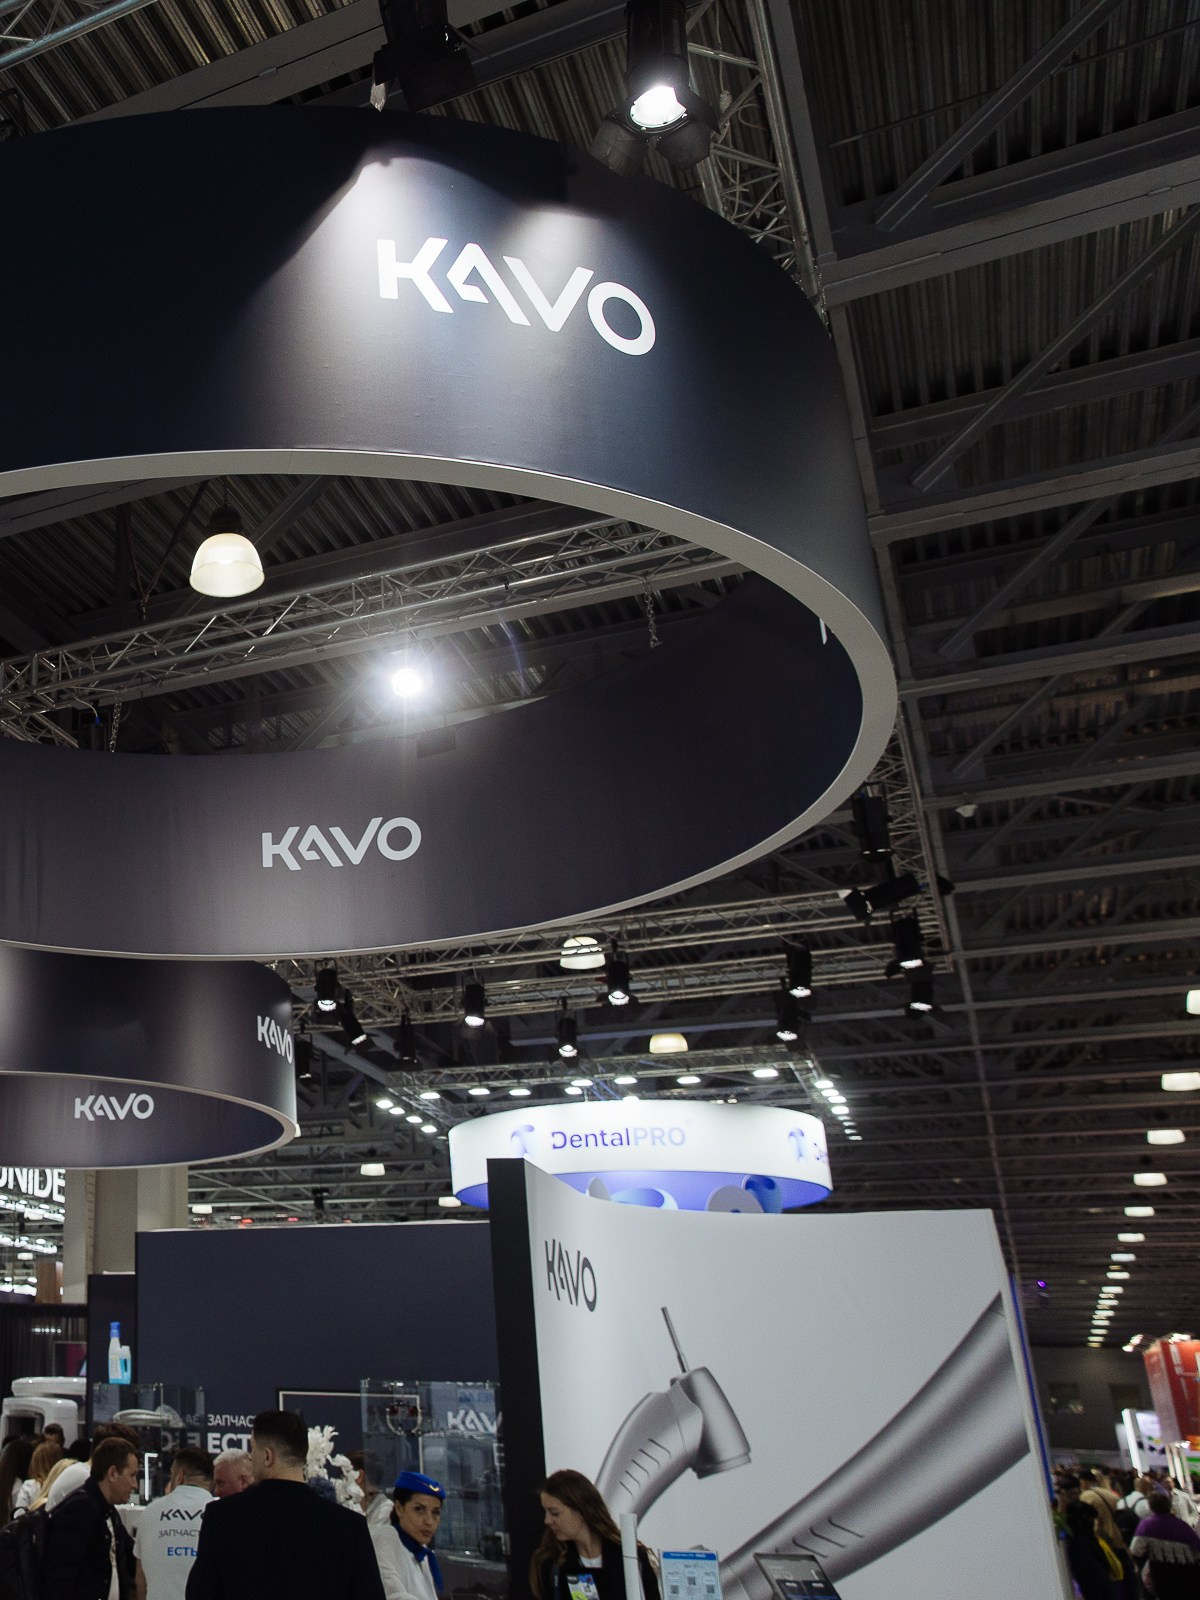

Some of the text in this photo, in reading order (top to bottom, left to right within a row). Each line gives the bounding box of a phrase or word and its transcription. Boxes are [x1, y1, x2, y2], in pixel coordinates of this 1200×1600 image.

[377, 237, 656, 355] KAVO
[261, 816, 422, 871] KAVO
[257, 1015, 293, 1064] KAVO
[74, 1093, 155, 1121] KAVO
[551, 1126, 686, 1150] DentalPRO
[544, 1238, 597, 1312] KAVO
